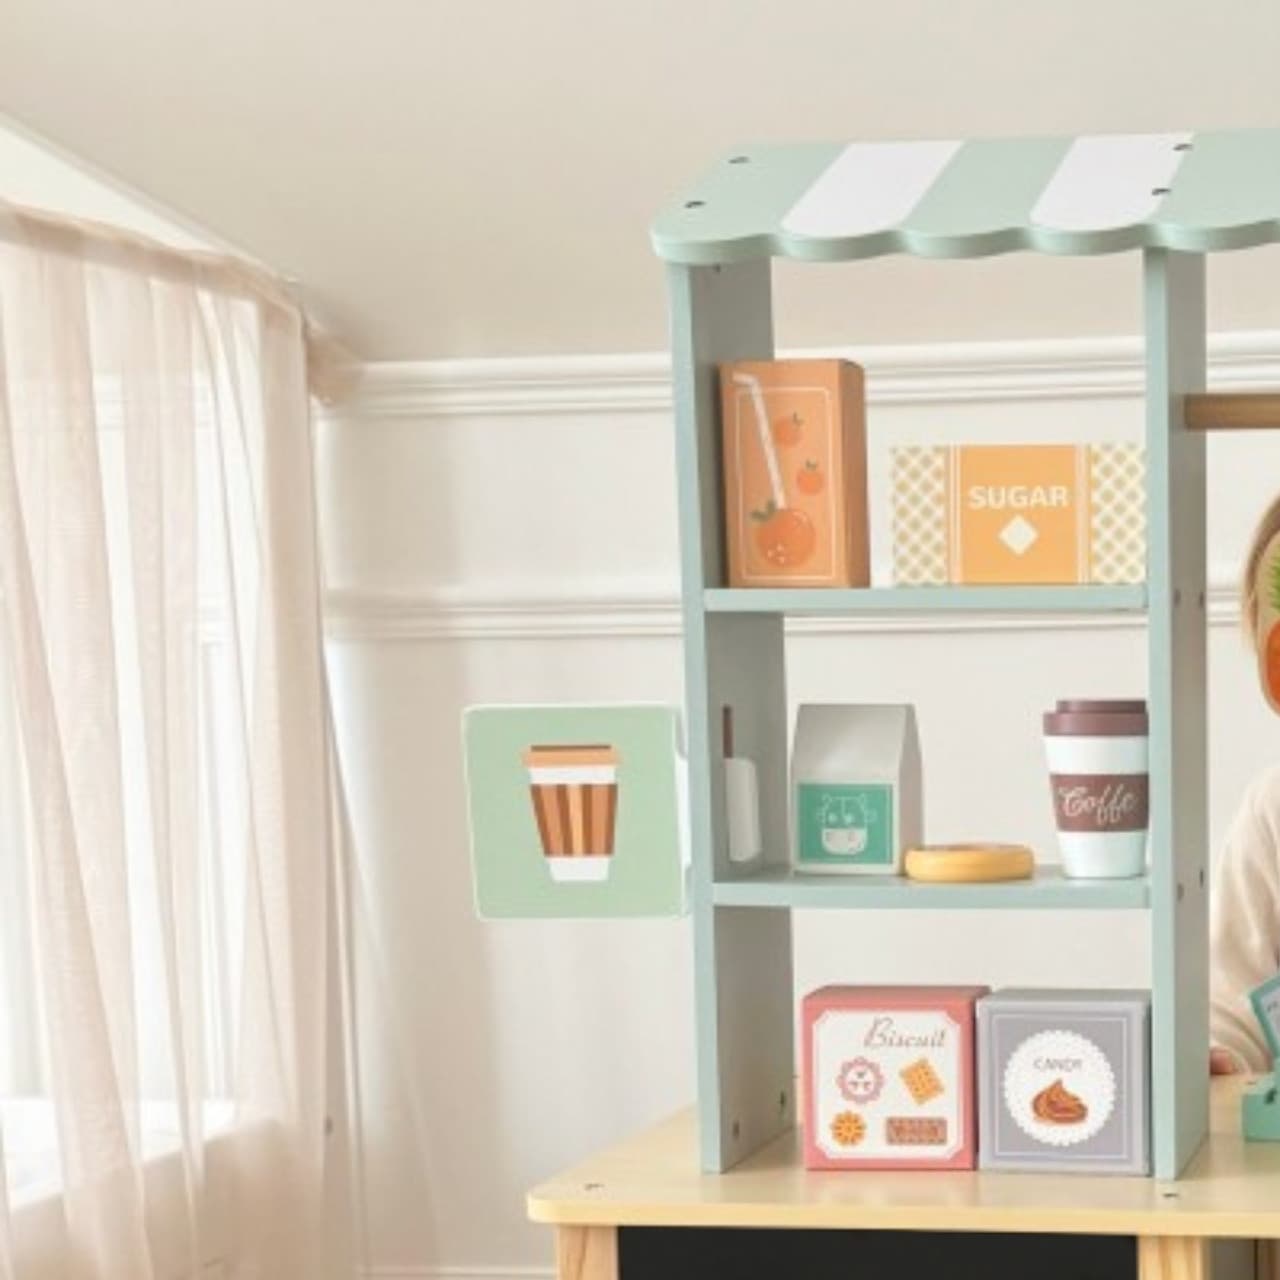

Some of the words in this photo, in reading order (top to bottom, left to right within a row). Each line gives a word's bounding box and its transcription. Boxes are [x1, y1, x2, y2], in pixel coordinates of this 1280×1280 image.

[968, 484, 1070, 510] SUGAR
[862, 1015, 948, 1049] Biscuit
[1032, 1057, 1084, 1074] CANDY
